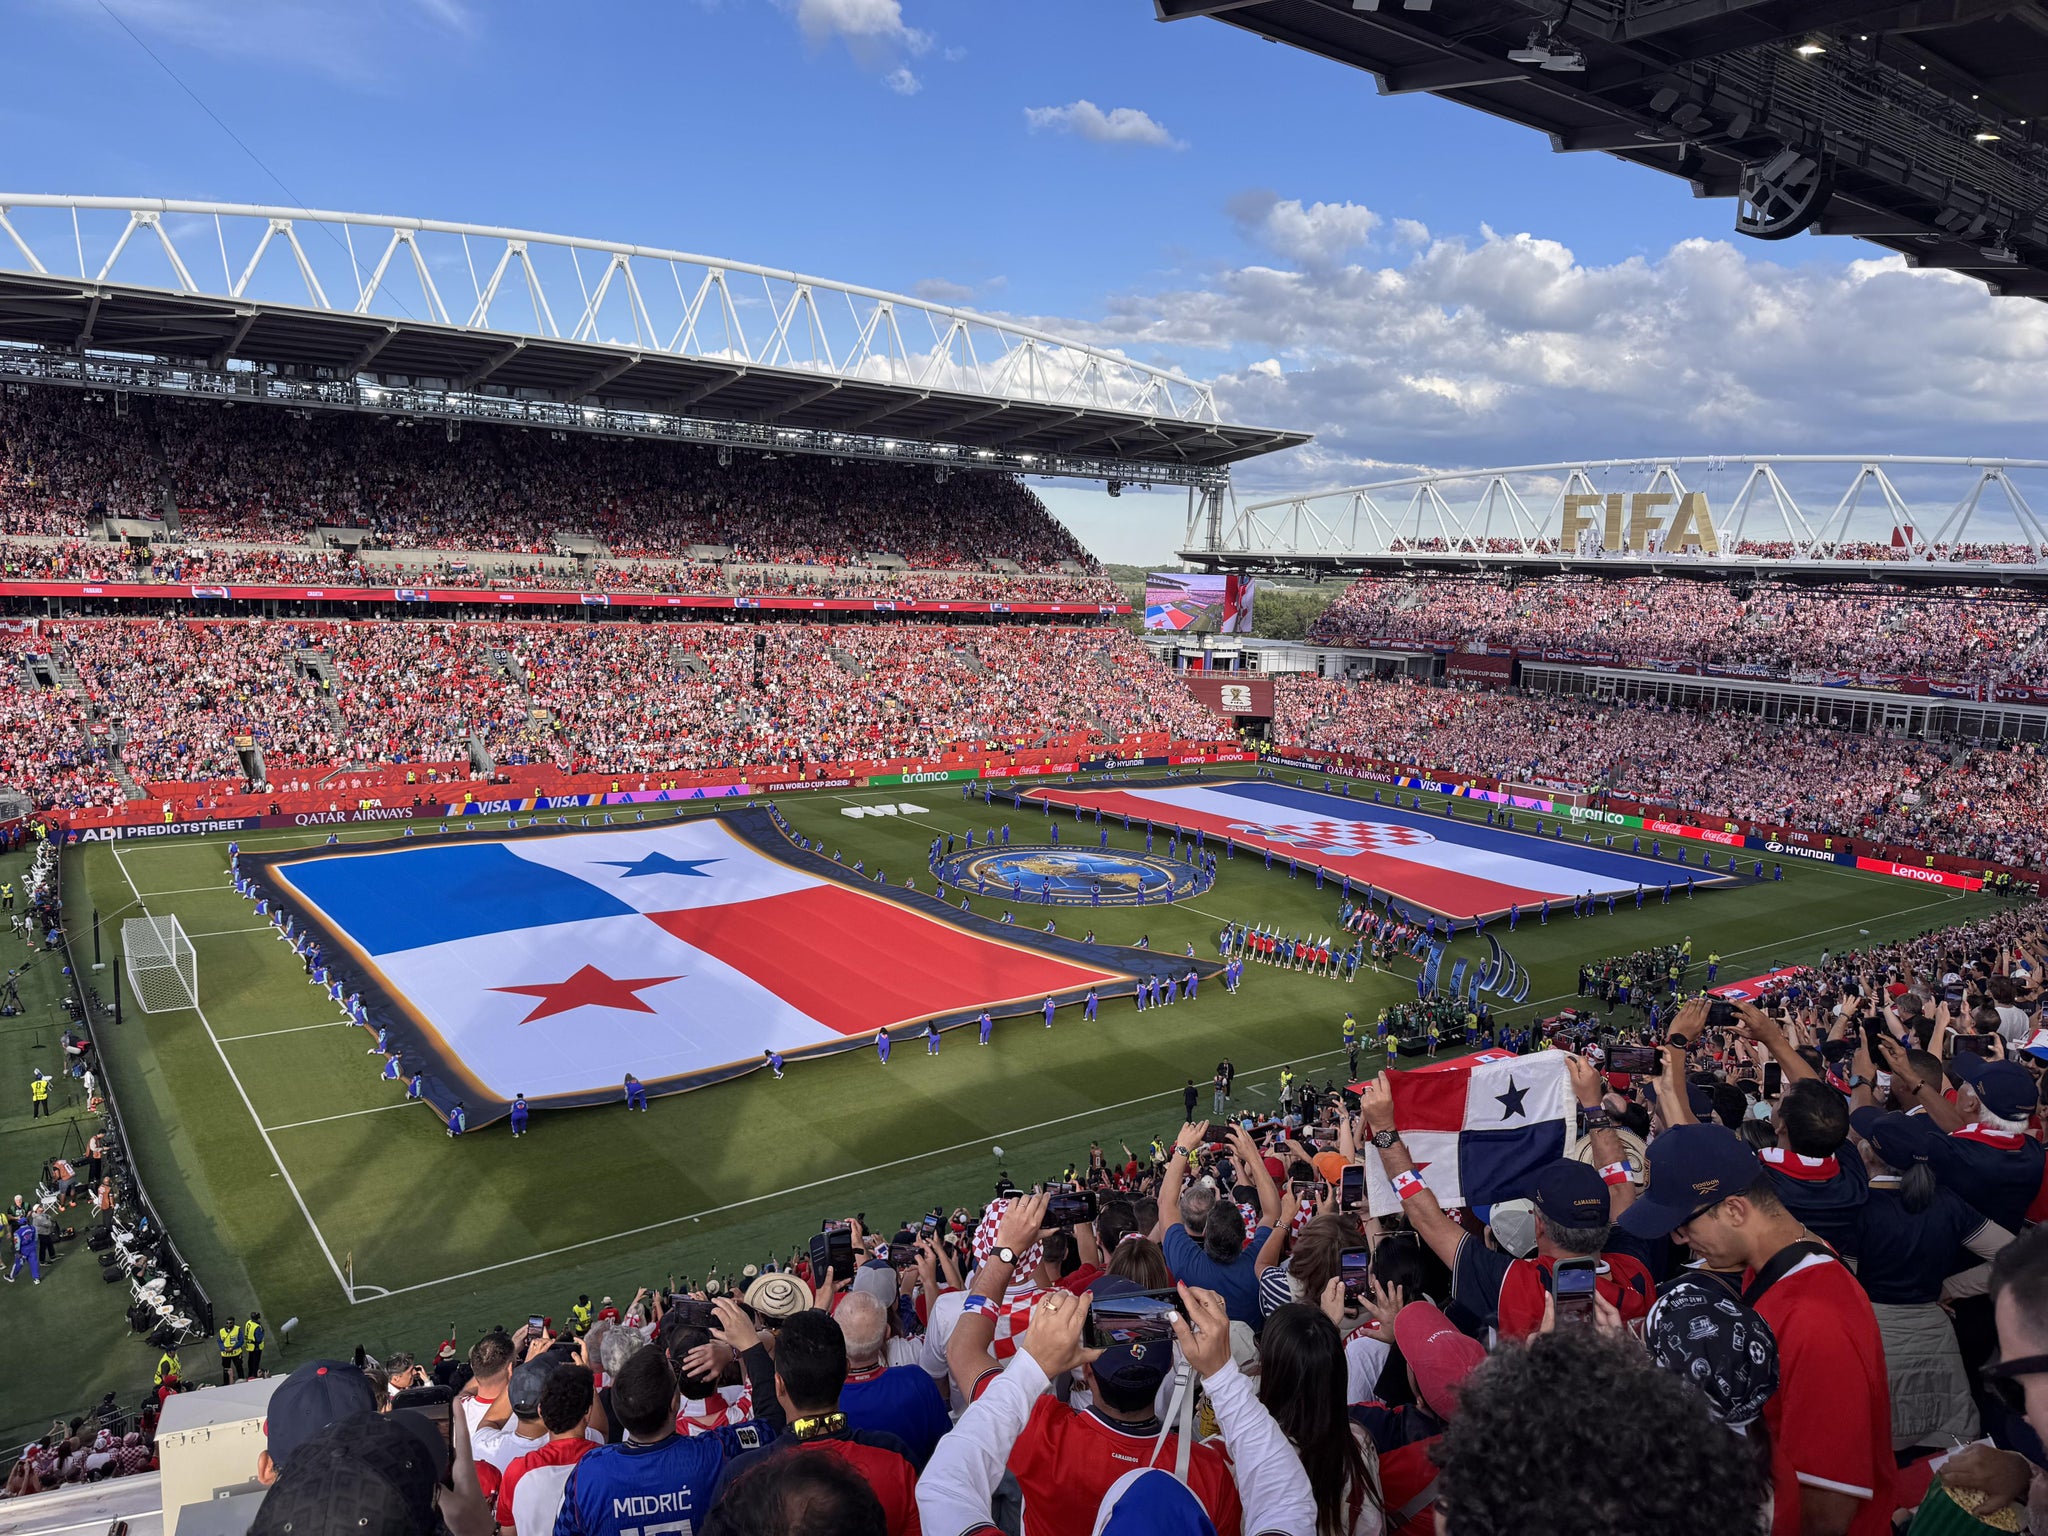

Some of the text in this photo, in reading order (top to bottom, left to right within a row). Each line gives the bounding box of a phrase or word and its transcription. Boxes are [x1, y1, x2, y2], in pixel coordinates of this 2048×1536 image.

[1561, 492, 1720, 551] FIFA
[1117, 759, 1145, 767] HYUNDAI
[1180, 752, 1243, 764] Lenovo Lenovo
[1267, 755, 1322, 771] ADI PREDICTSTREET
[902, 771, 949, 783] aramco
[1326, 765, 1391, 783] QATAR AIRWAYS
[1407, 767, 1419, 775] FIFA
[769, 780, 848, 791] FIFA WORLD CUP 2026
[1419, 779, 1442, 792] VISA
[359, 799, 382, 808] FFA
[475, 795, 580, 813] VISA VISA
[295, 807, 413, 826] QATAR AIRWAYS
[1569, 805, 1624, 825] aramco
[82, 819, 244, 842] ADI PREDICTSTREET
[1791, 832, 1809, 842] FIFA
[1785, 845, 1834, 862] HYUNDAI
[1892, 863, 1943, 883] Lenovo
[613, 1485, 692, 1518] MODRIĆ
